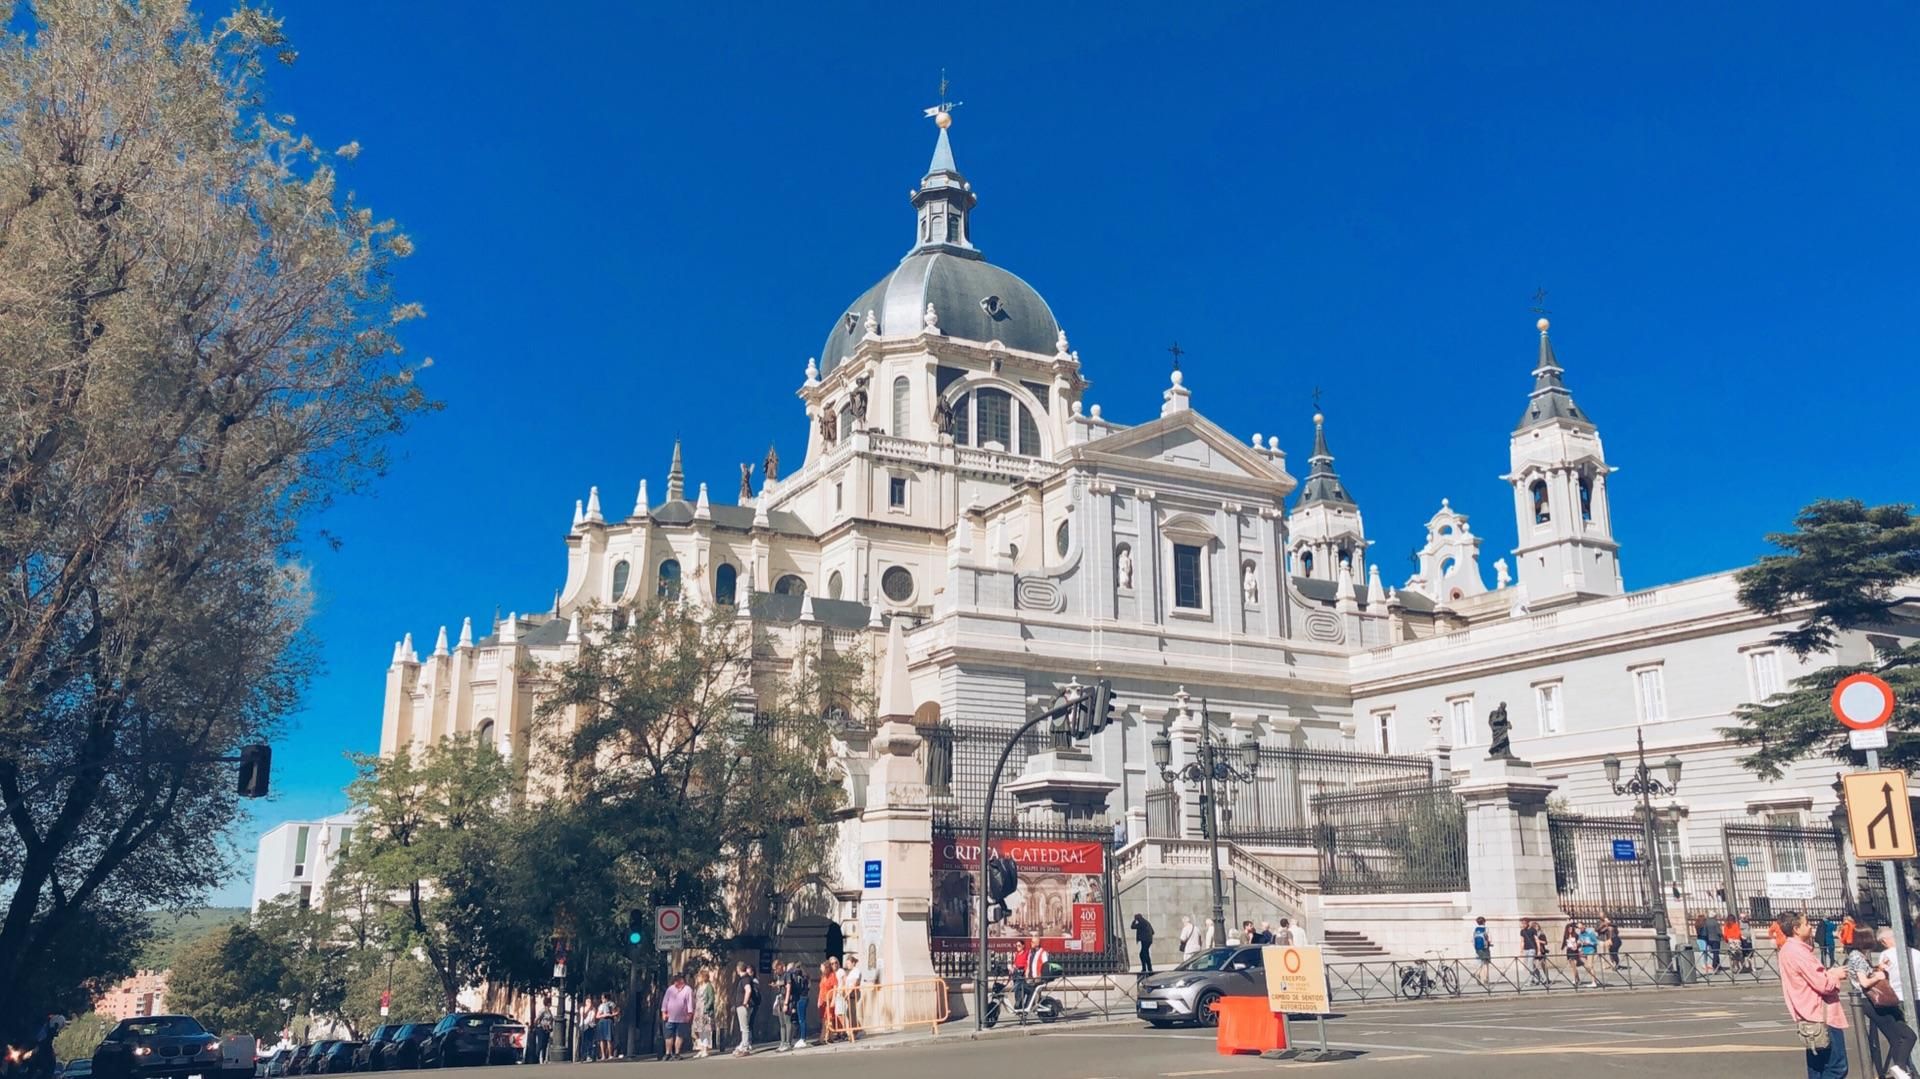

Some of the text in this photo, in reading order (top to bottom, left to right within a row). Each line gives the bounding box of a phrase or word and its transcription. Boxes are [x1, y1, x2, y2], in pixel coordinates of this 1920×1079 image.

[944, 845, 999, 861] CRIPA
[1011, 848, 1086, 863] CATEDRAL
[1080, 911, 1096, 921] 400
